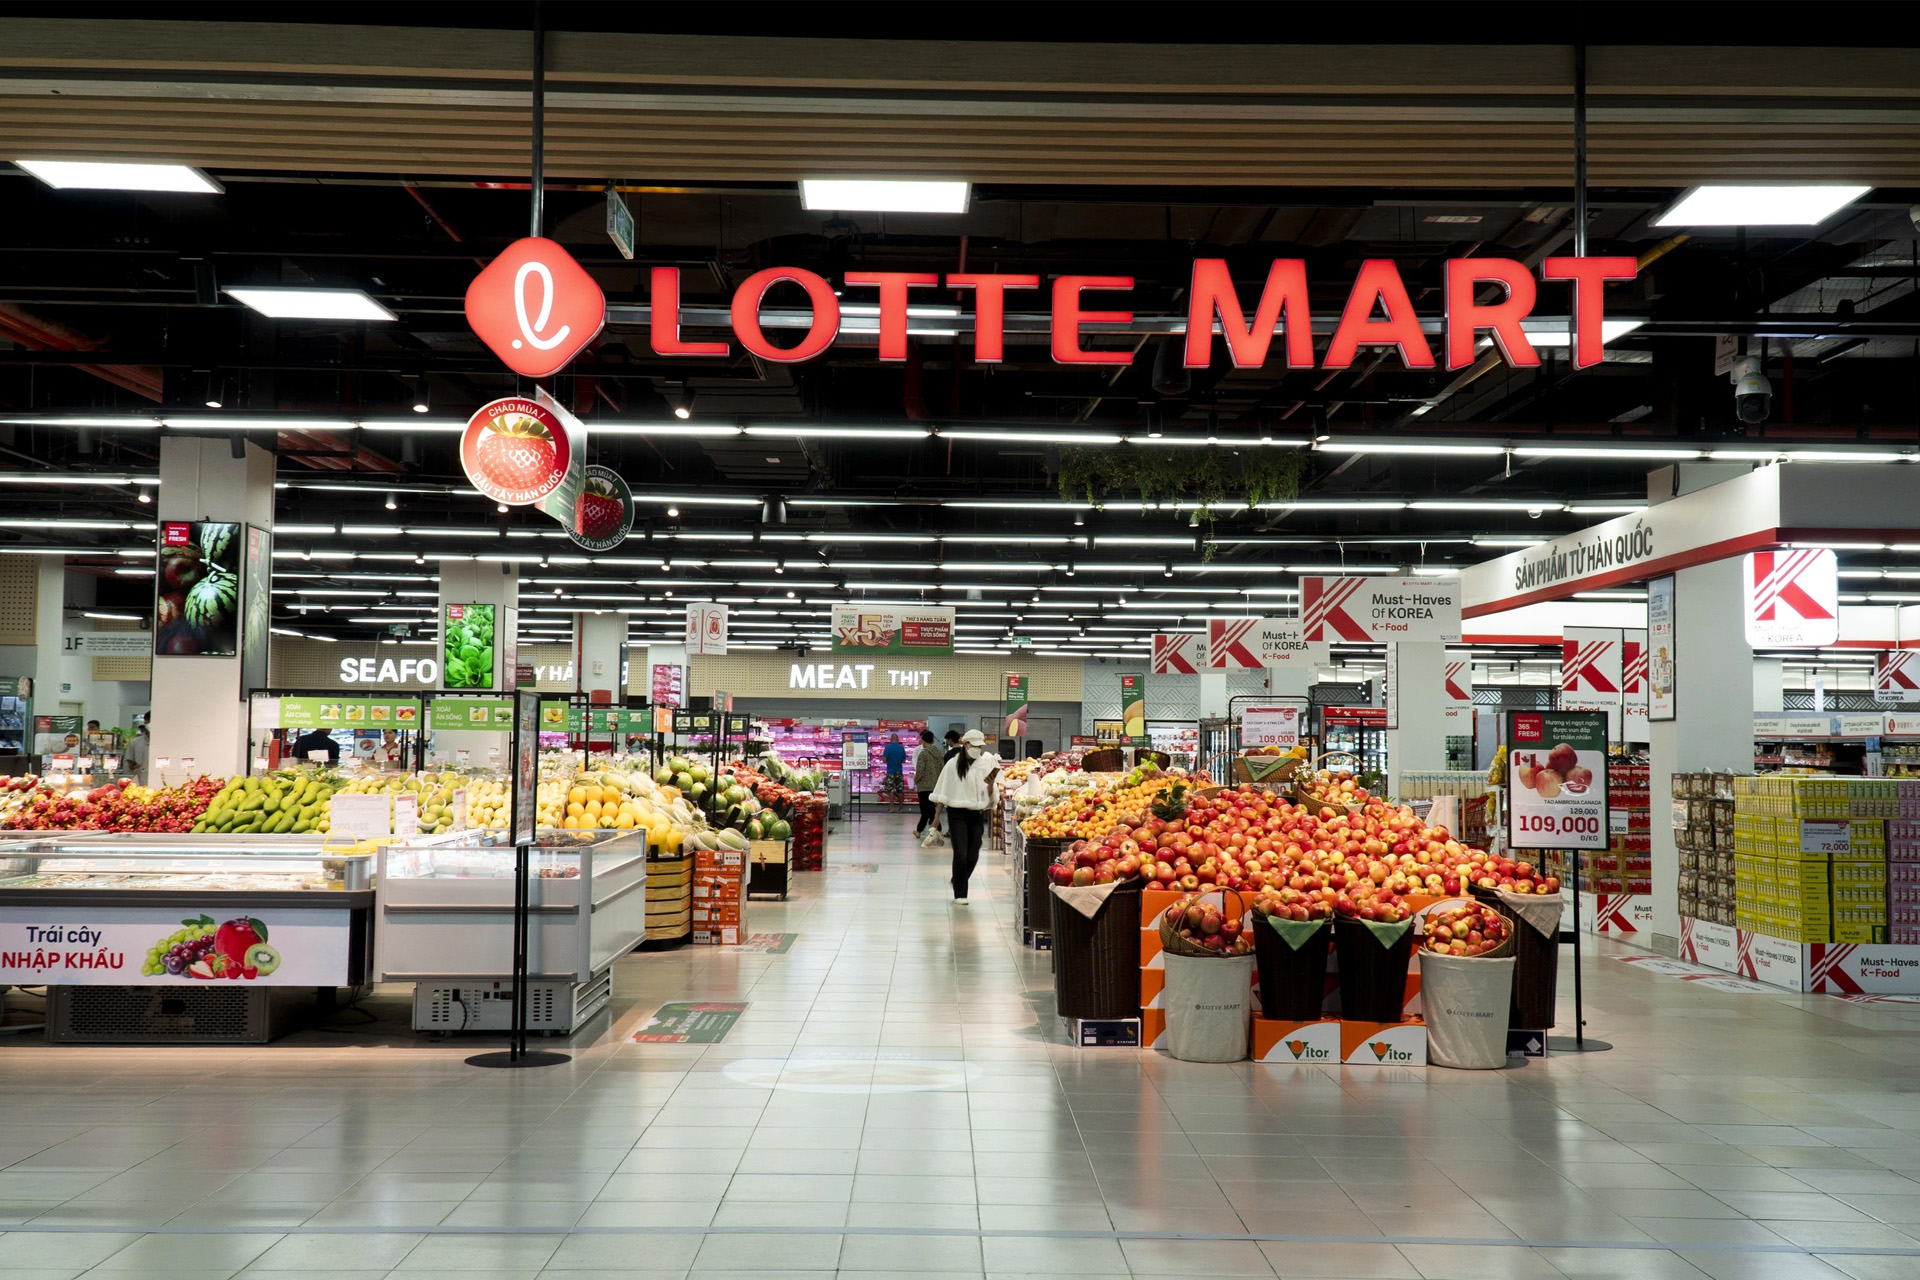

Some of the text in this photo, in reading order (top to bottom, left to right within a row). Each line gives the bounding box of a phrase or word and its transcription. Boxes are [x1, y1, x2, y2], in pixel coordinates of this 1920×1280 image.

[651, 256, 1637, 373] LOTTE MART
[488, 403, 516, 417] CHÀO
[516, 489, 540, 501] HÀN
[539, 469, 563, 493] QUỐC
[1515, 518, 1653, 590] SẢN PHẨM TỪ HÀN QUỐC
[1371, 594, 1451, 605] Must-Haves
[1371, 607, 1434, 619] Of KOREA
[1371, 622, 1408, 632] K-Food
[65, 637, 84, 650] 1F
[1768, 634, 1803, 643] KOREA
[1262, 641, 1309, 651] Of KOREA
[1262, 652, 1290, 660] K-Food
[789, 663, 932, 690] MEAT THỊT
[1258, 735, 1295, 745] 109,000
[1570, 807, 1599, 816] 129,000
[1519, 815, 1599, 835] 109,000
[1820, 843, 1850, 851] 72,000
[26, 925, 102, 947] Trái cây
[1695, 932, 1715, 944] Must-Haves
[1718, 937, 1731, 948] KOREA
[1696, 941, 1709, 952] K-Food
[1, 947, 124, 974] NHẬP KHẨU
[1754, 947, 1778, 960] Must-Haves
[1782, 953, 1797, 965] KOREA
[1755, 956, 1771, 968] K-Food
[1860, 957, 1919, 967] Must-Haves
[1860, 968, 1900, 978] K-Food
[1285, 1040, 1329, 1061] Vitor
[1368, 1041, 1413, 1063] Vitor
